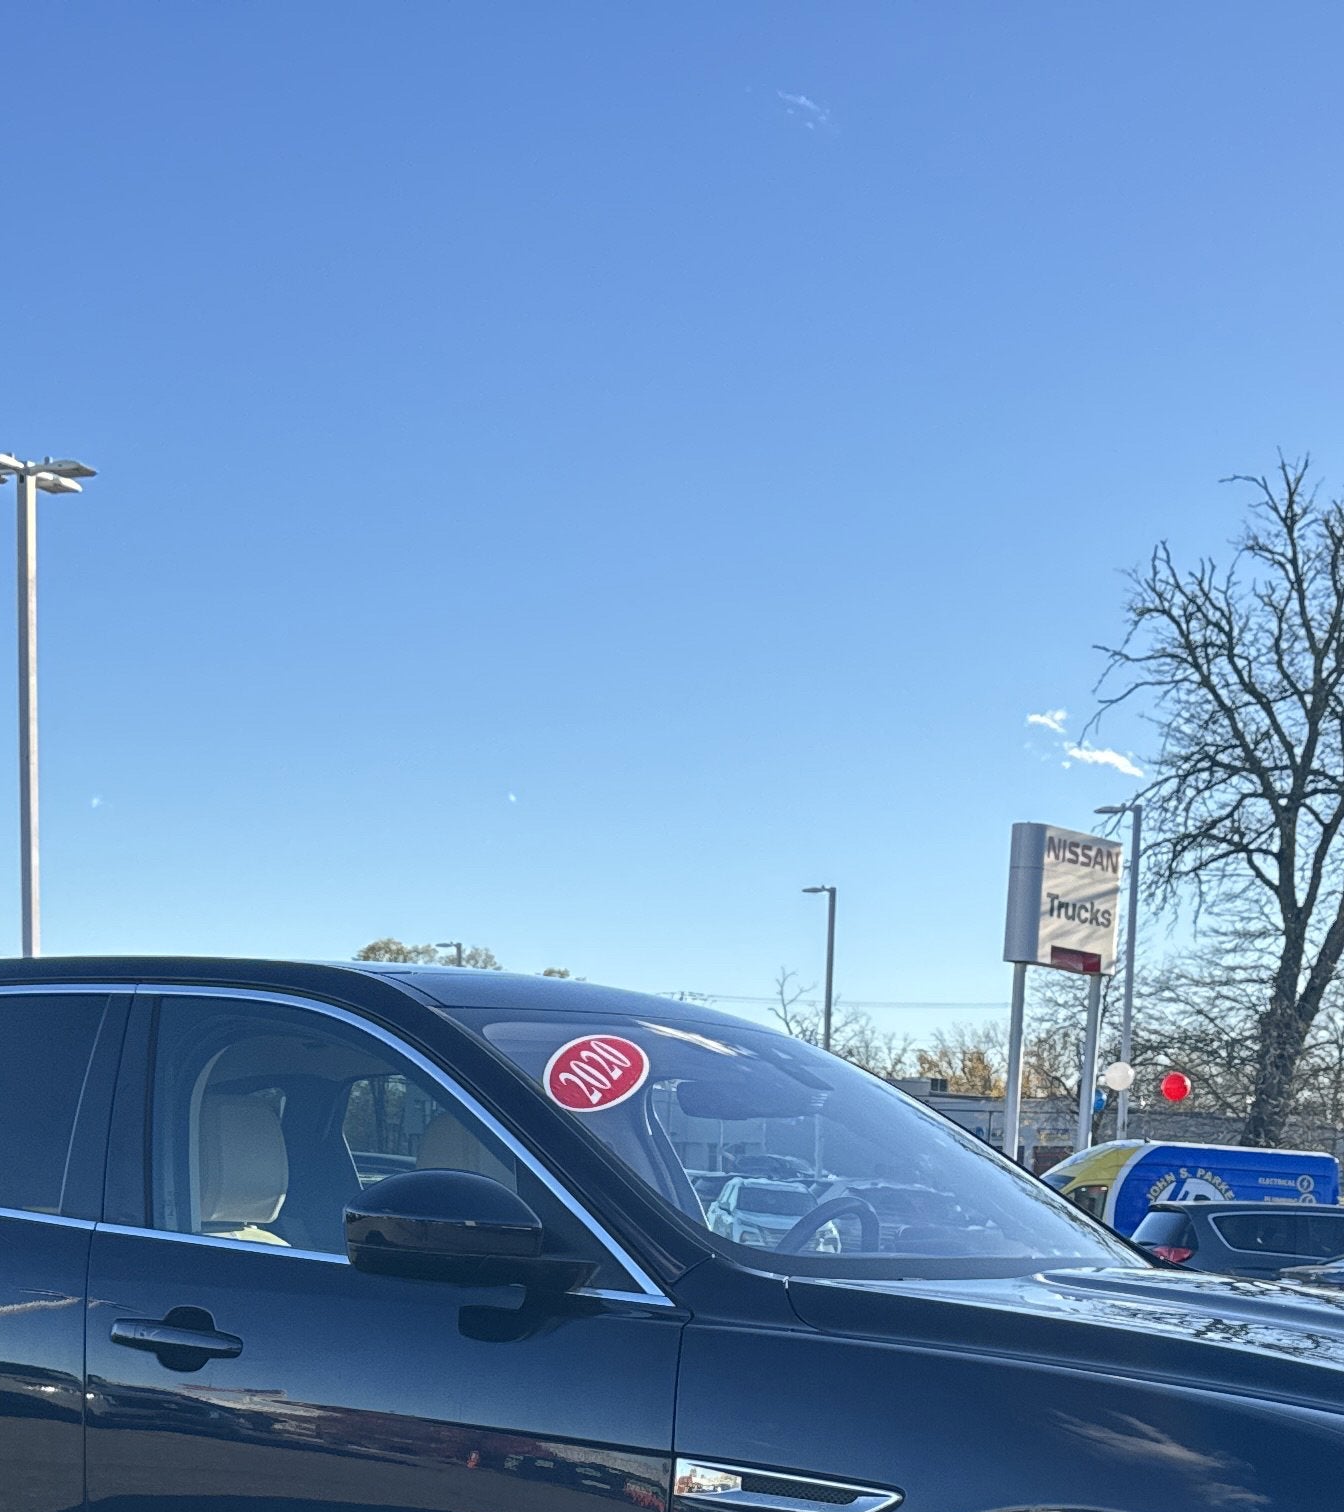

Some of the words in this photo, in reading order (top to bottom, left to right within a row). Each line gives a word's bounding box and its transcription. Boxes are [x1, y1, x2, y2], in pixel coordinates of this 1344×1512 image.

[1047, 836, 1120, 874] NISSAN
[1046, 892, 1112, 928] Trucks
[558, 1040, 632, 1105] 2020
[1147, 1171, 1177, 1202] JOHN
